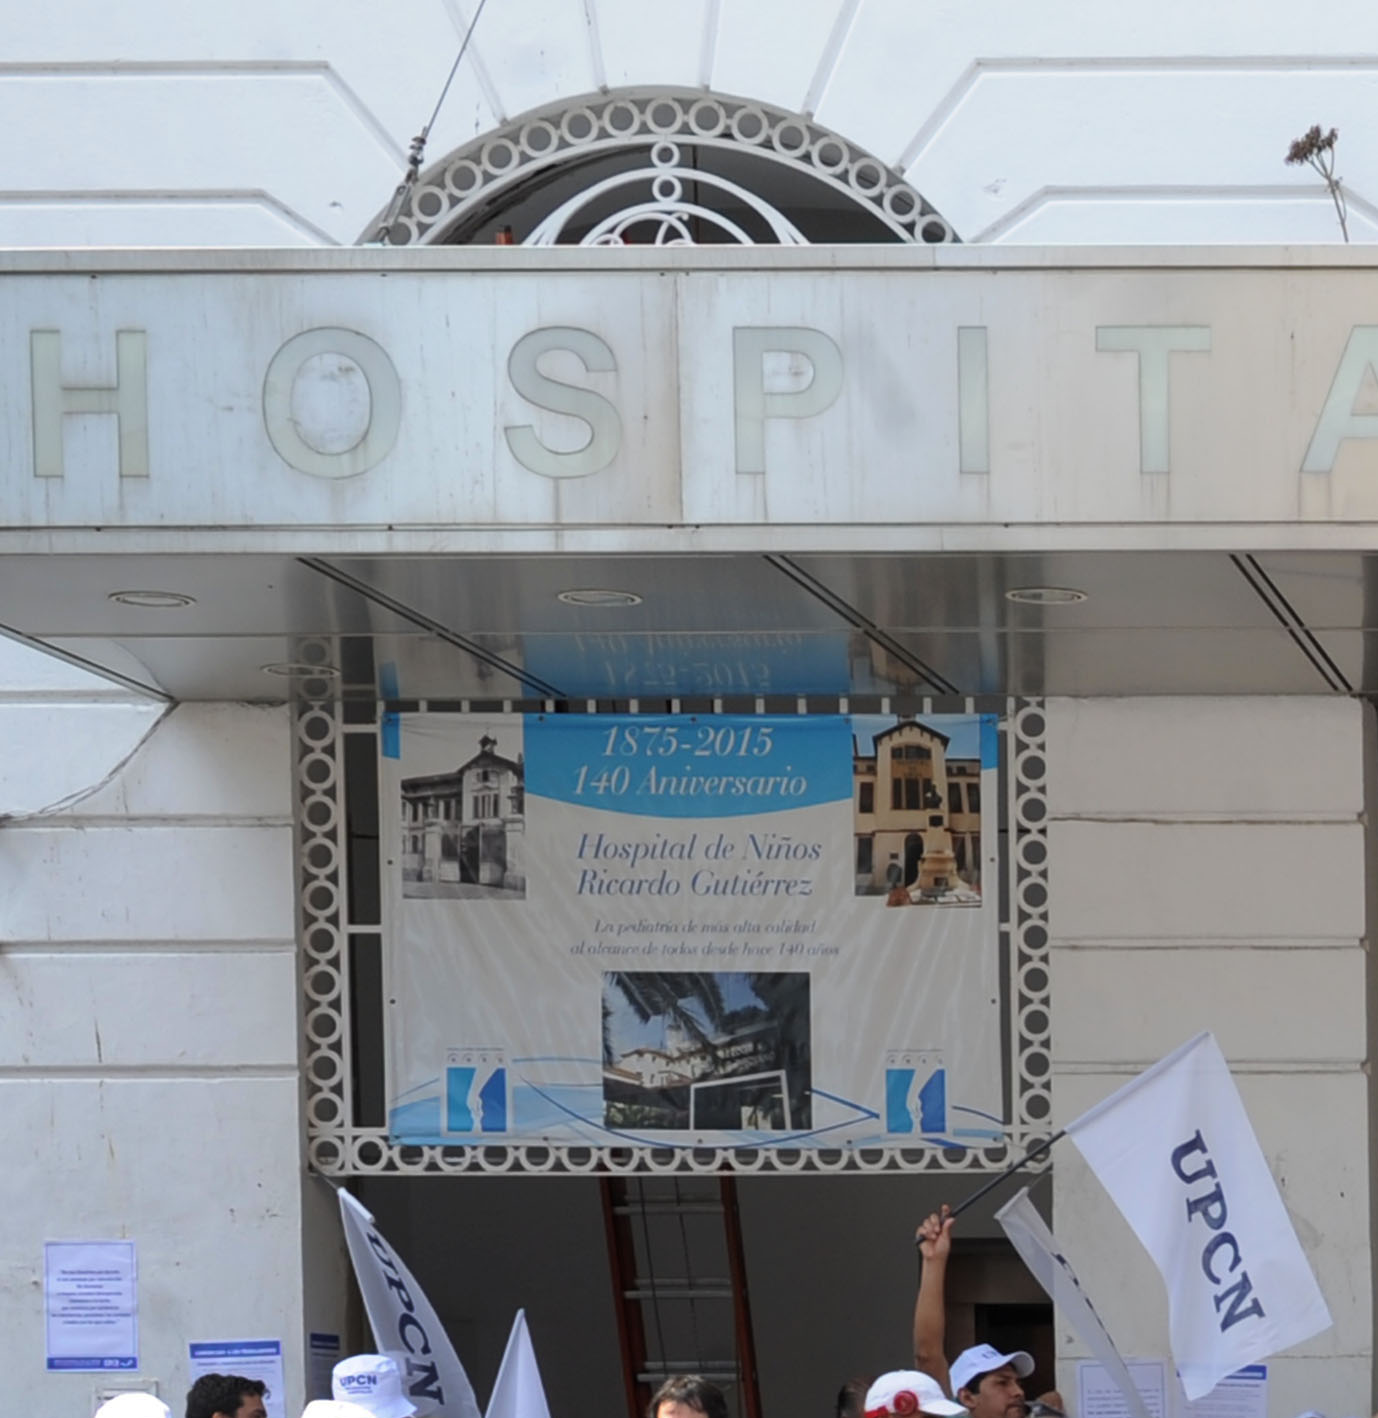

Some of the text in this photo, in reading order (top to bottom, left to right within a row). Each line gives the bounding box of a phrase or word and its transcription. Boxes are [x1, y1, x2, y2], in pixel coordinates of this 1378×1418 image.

[602, 726, 774, 757] 1875-2015
[572, 765, 809, 797] 140 Aniversario
[576, 832, 822, 868] Hospital de Niños
[577, 869, 813, 896] Ricardo Gutiérrez
[1170, 1129, 1266, 1334] UPCN
[366, 1231, 445, 1406] UPCN
[340, 1374, 378, 1387] UPCN
